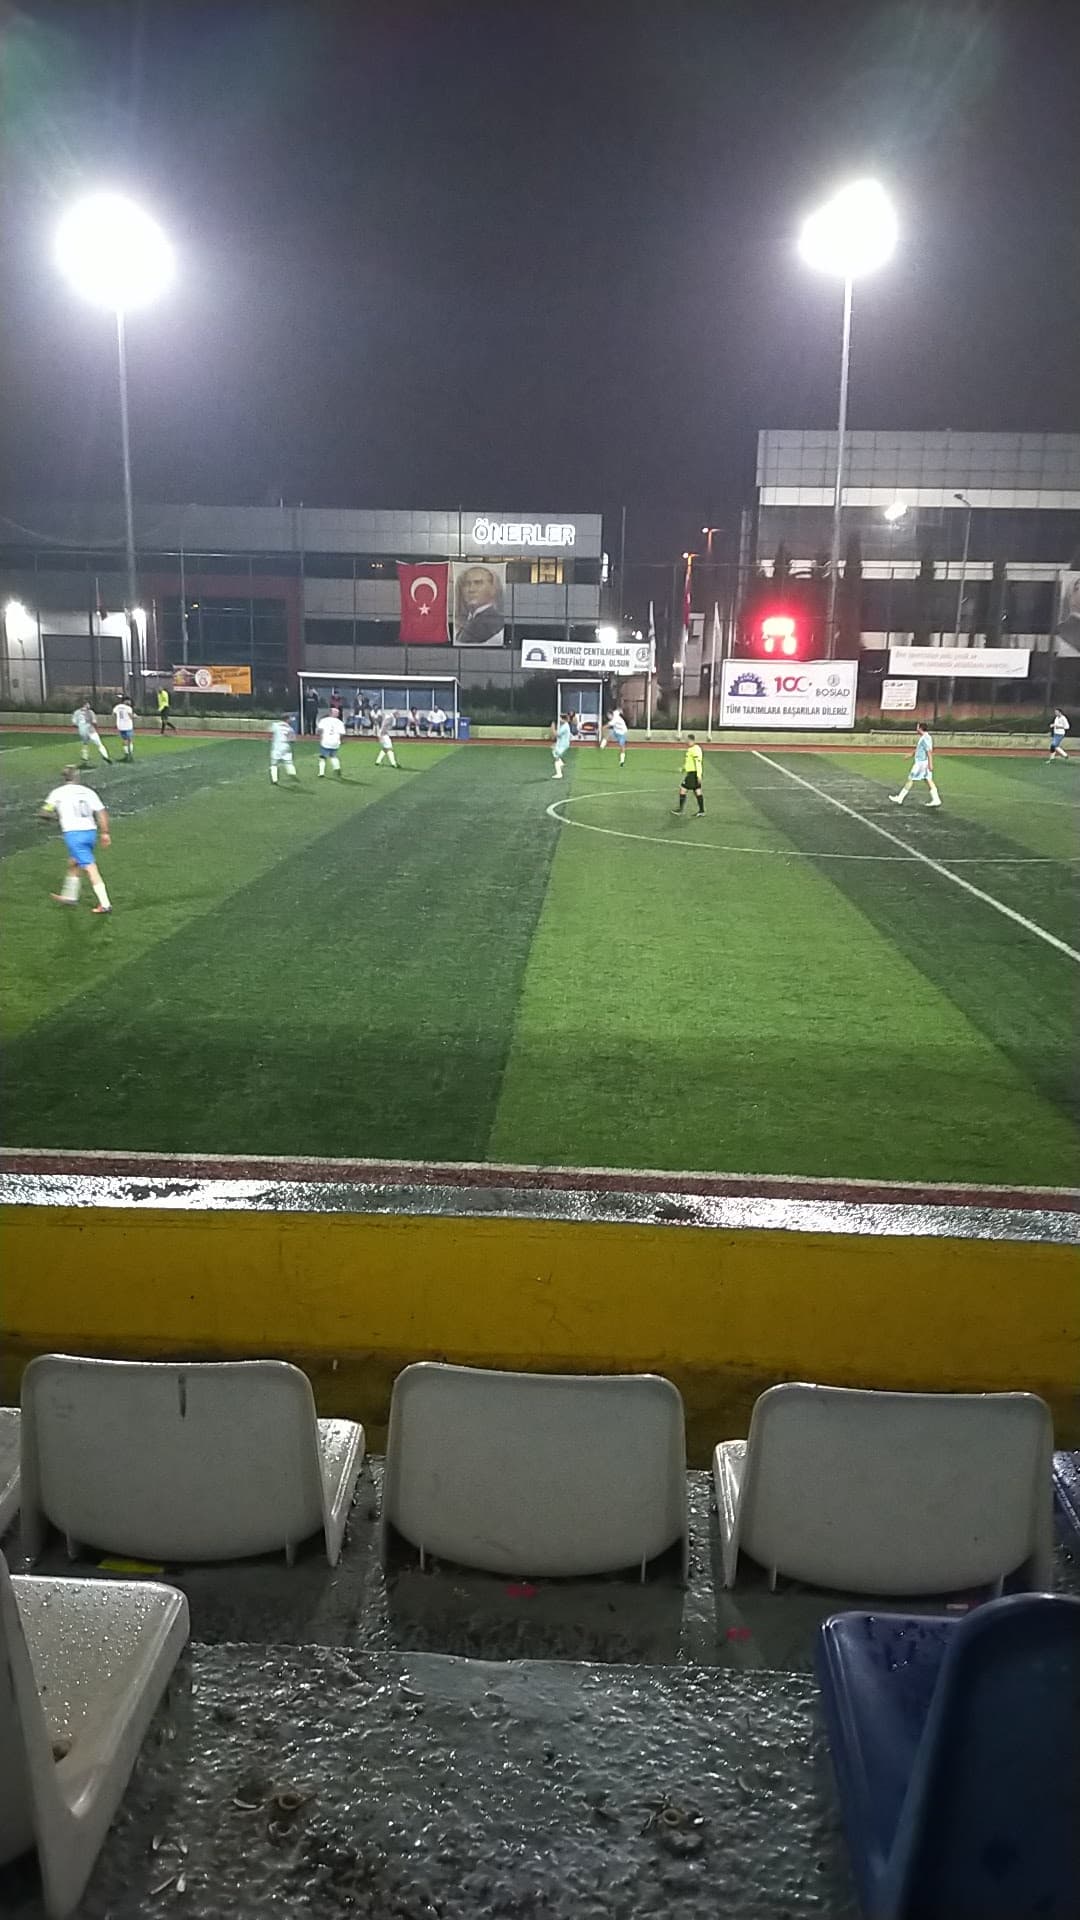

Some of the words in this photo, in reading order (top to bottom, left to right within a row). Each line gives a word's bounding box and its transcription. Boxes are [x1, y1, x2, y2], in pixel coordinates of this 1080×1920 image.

[473, 518, 575, 545] ÖNERLER
[588, 658, 606, 667] KUPA
[608, 659, 630, 668] OLSUN
[726, 703, 741, 714] TÜM
[743, 705, 781, 715] TAKIMLARA
[782, 705, 820, 718] BAŞARILAR
